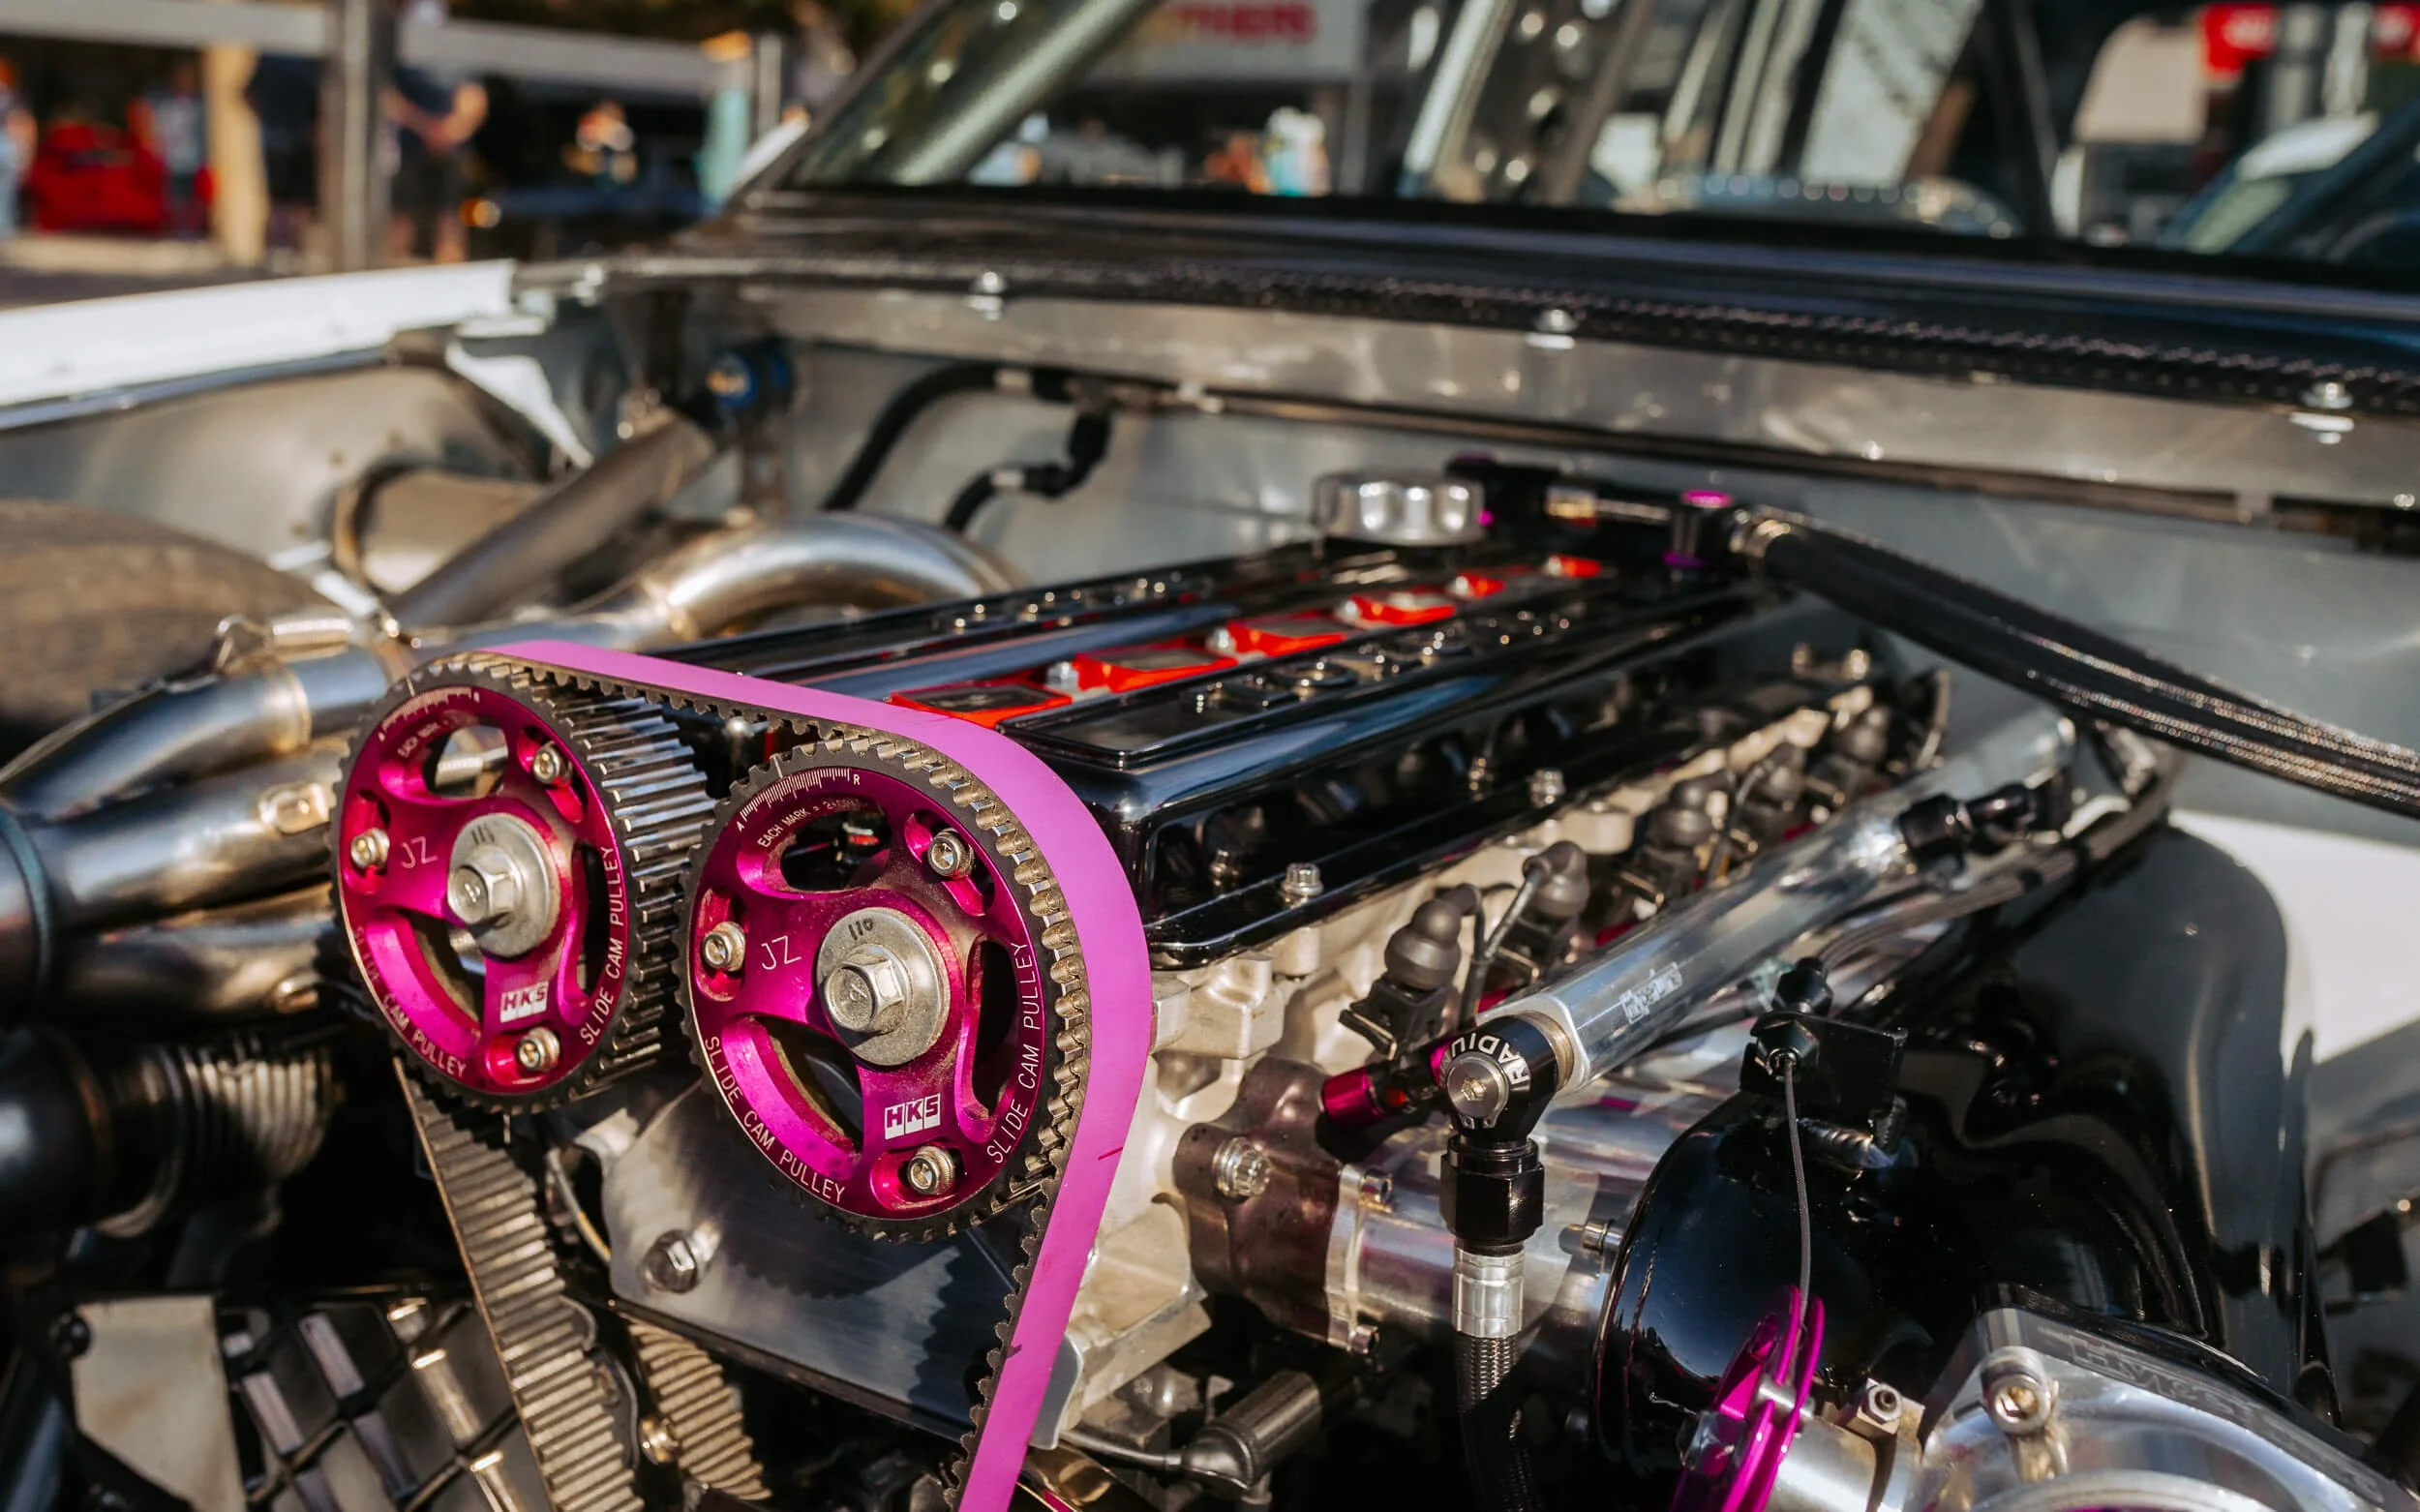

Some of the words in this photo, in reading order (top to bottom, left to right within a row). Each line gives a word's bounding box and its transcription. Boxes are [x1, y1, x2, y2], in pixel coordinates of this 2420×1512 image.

[853, 773, 861, 785] R
[736, 821, 745, 832] A
[757, 823, 783, 848] EACH
[781, 807, 811, 828] MARK
[401, 836, 439, 869] JZ
[600, 846, 624, 927] PULLEY
[605, 938, 624, 980] CAM
[761, 935, 802, 971] JZ
[500, 983, 550, 1019] HKS
[1011, 942, 1041, 1030] PULLEY
[383, 993, 410, 1031] CAM
[411, 1029, 467, 1077] PULLEY
[580, 986, 615, 1046] SLIDE
[1018, 1043, 1041, 1089] CAM
[705, 1036, 743, 1104] SLIDE
[743, 1110, 775, 1151] CAM
[779, 1149, 845, 1203] PULLEY
[885, 1094, 941, 1136] HKS
[986, 1099, 1029, 1164] SLIDE
